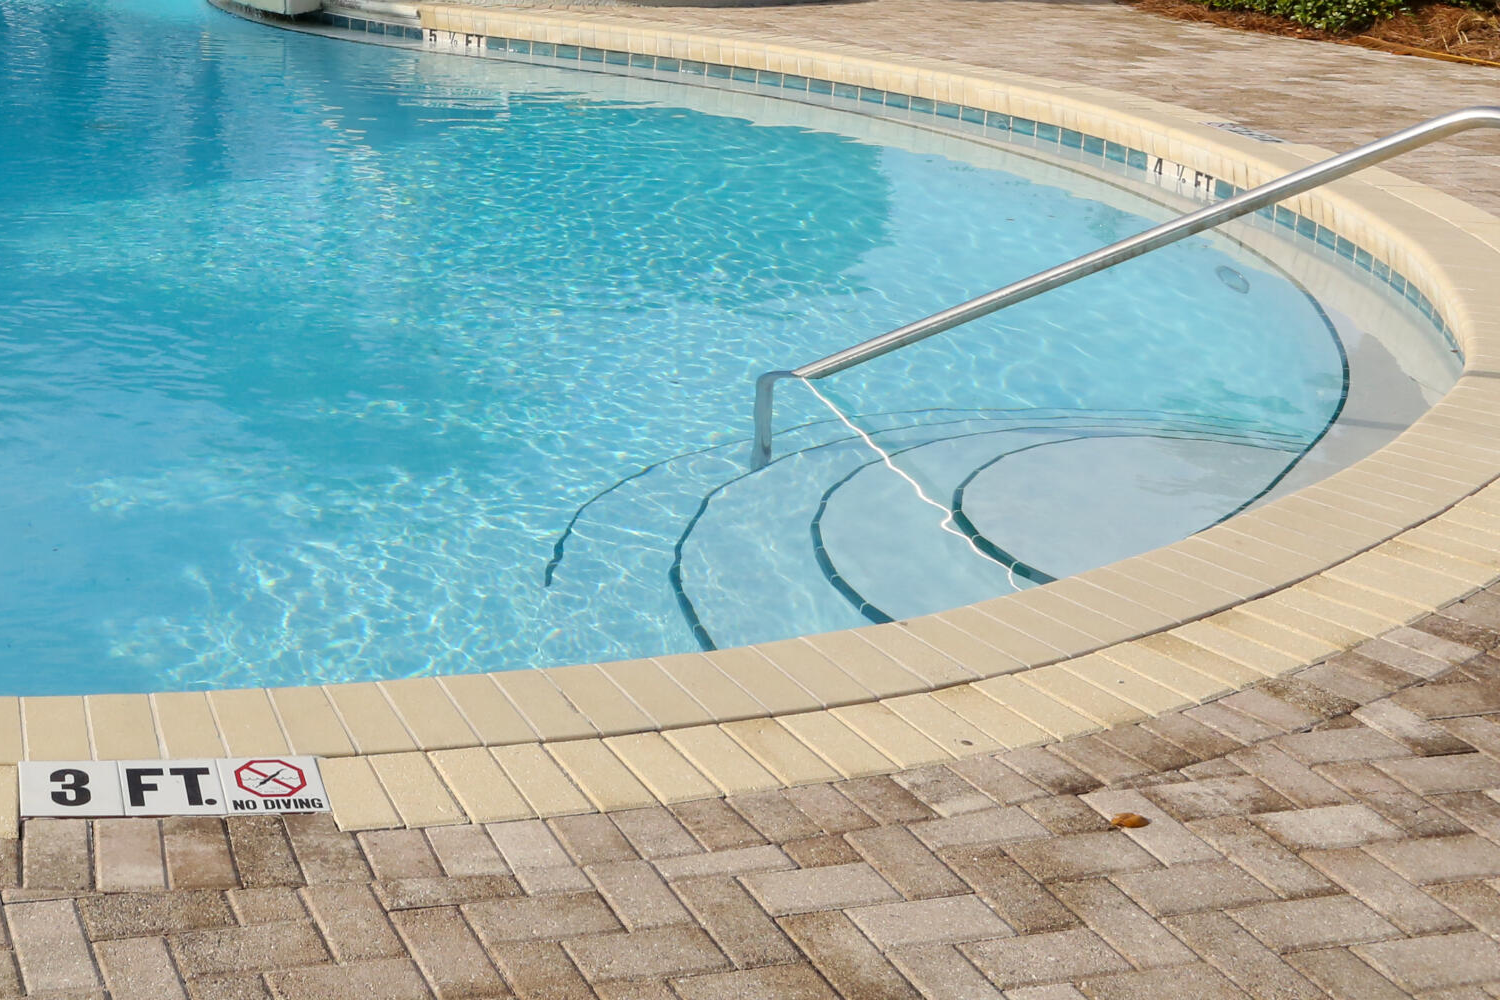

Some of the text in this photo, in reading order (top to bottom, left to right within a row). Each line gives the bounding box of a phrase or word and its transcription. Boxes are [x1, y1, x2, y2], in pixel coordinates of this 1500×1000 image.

[429, 29, 436, 42] 5
[465, 33, 483, 48] FT
[1154, 158, 1163, 175] 4
[1194, 170, 1213, 192] FT
[50, 767, 218, 807] 3 FT.
[233, 798, 323, 810] NO DIVING
